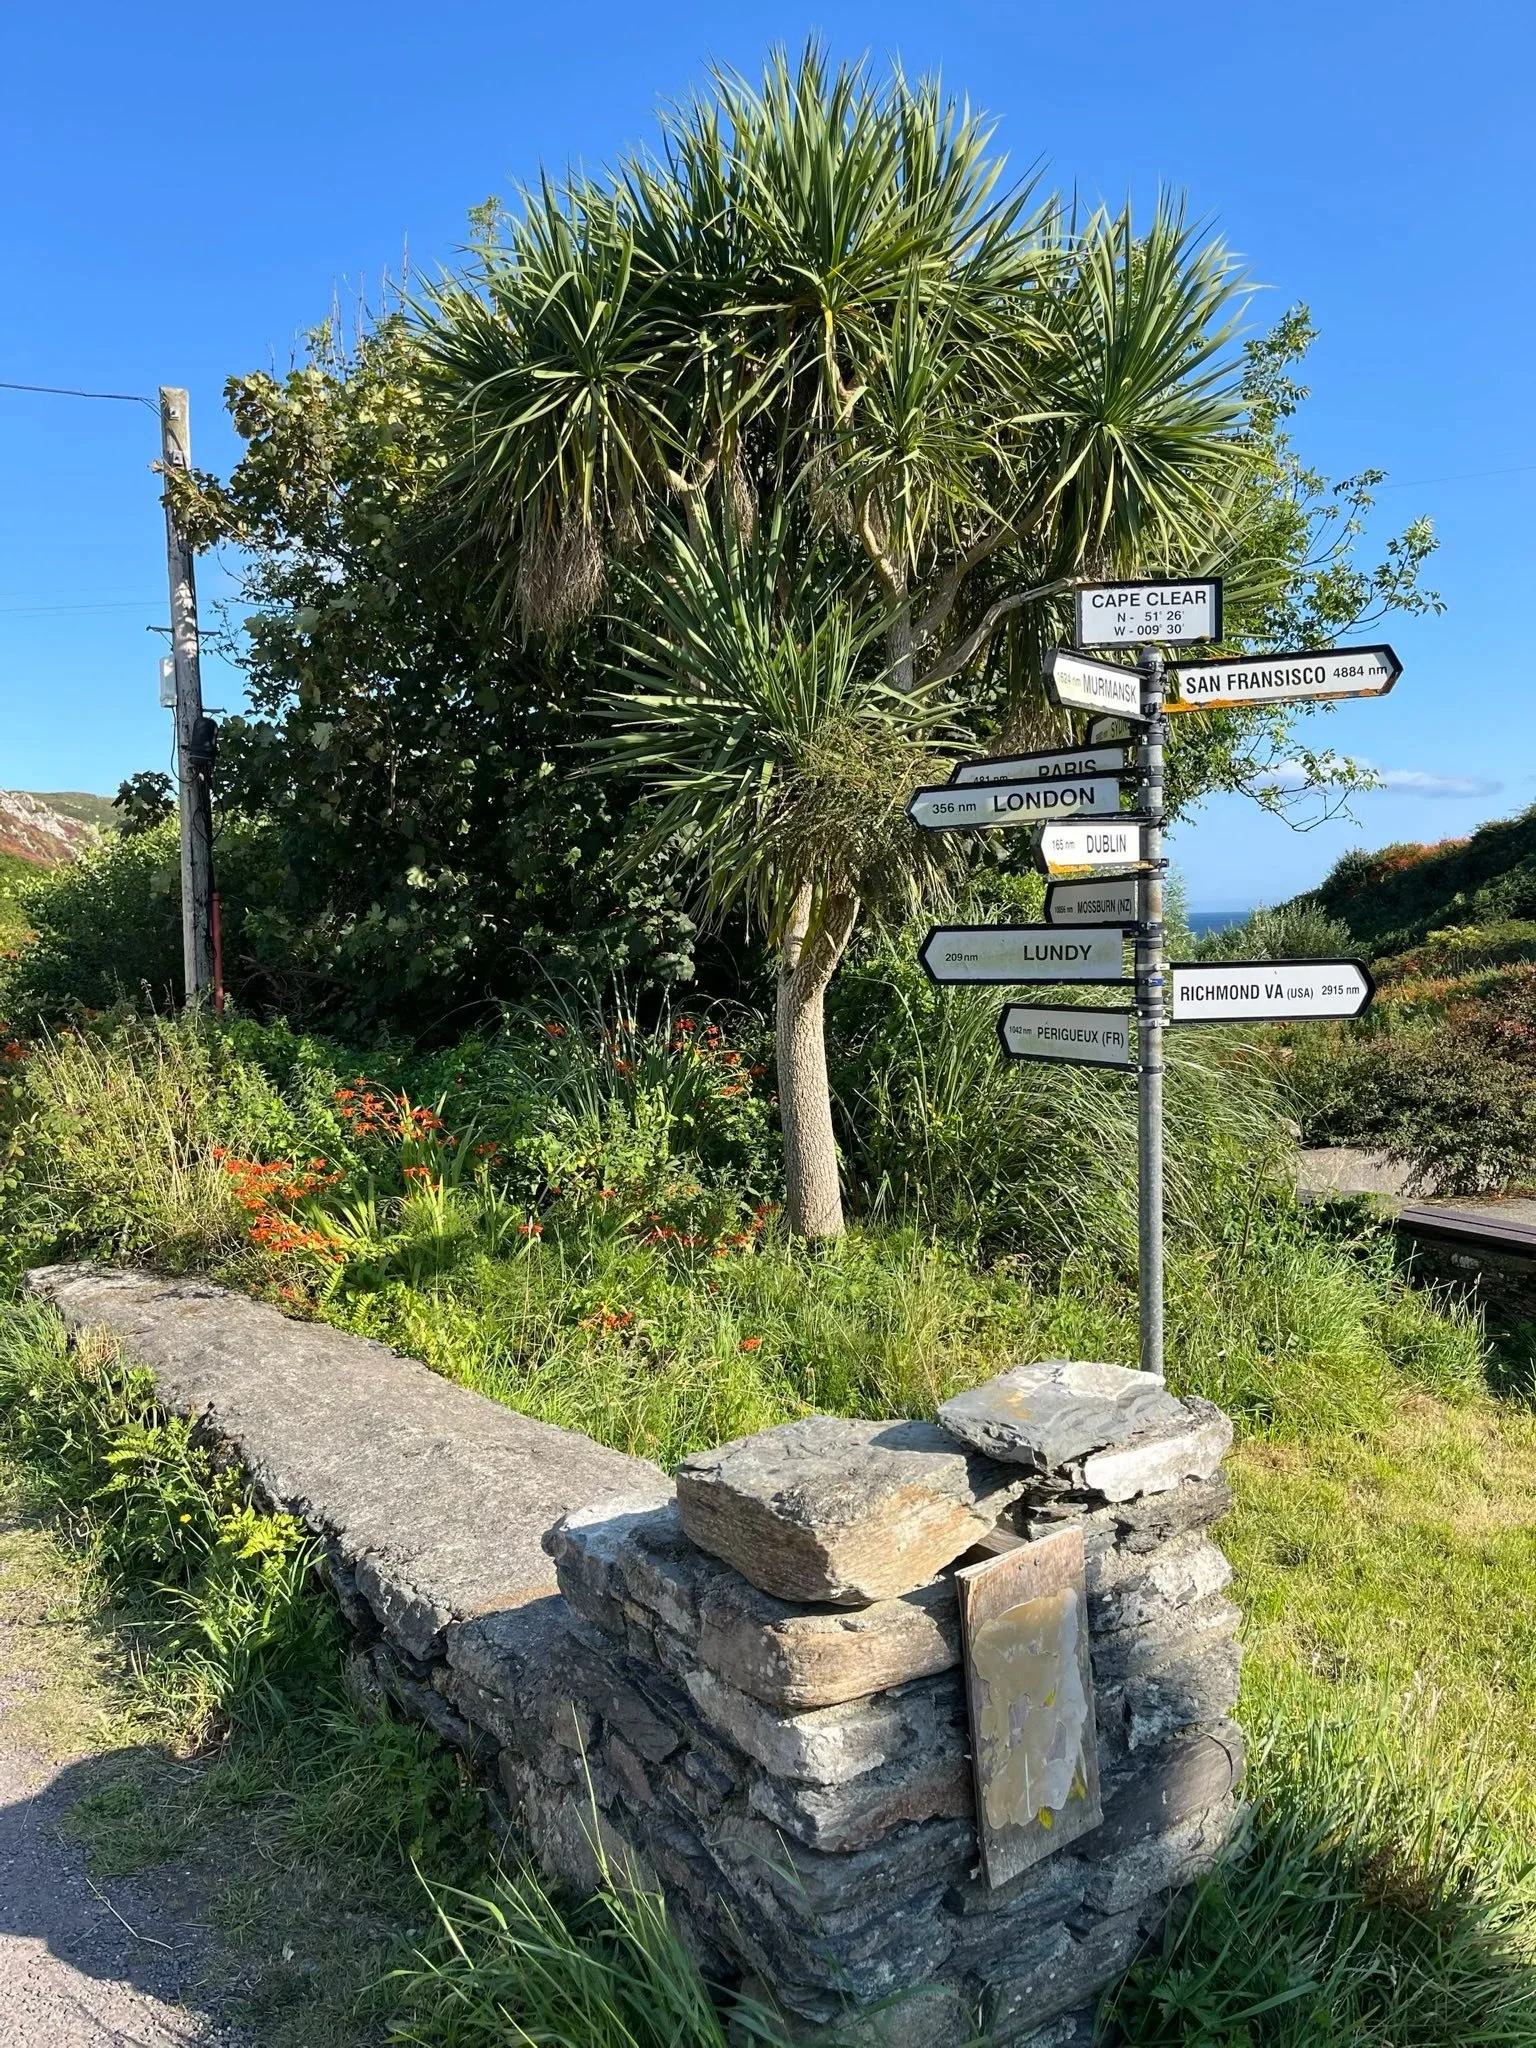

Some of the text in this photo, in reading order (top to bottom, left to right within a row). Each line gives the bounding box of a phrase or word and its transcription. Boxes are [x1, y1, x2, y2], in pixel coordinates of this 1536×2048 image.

[1092, 590, 1206, 608] CAPE CLEAR
[1117, 612, 1126, 622] N
[1114, 626, 1126, 636] W
[1082, 673, 1137, 704] MURMANSK
[1186, 665, 1388, 694] SAN FRANSISCO 4884 nm
[1038, 759, 1097, 778] PARIS
[932, 786, 1095, 814] 356 nm LONDON
[1086, 834, 1127, 854] DUBLIN
[1077, 899, 1116, 914] MOSSBURN
[945, 944, 1092, 962] 209 nm LUNDY
[1180, 983, 1361, 1002] RICHMOND VA (USA) 2915 nm
[1009, 1026, 1022, 1035] 1042
[1102, 1031, 1125, 1049] (FR)
